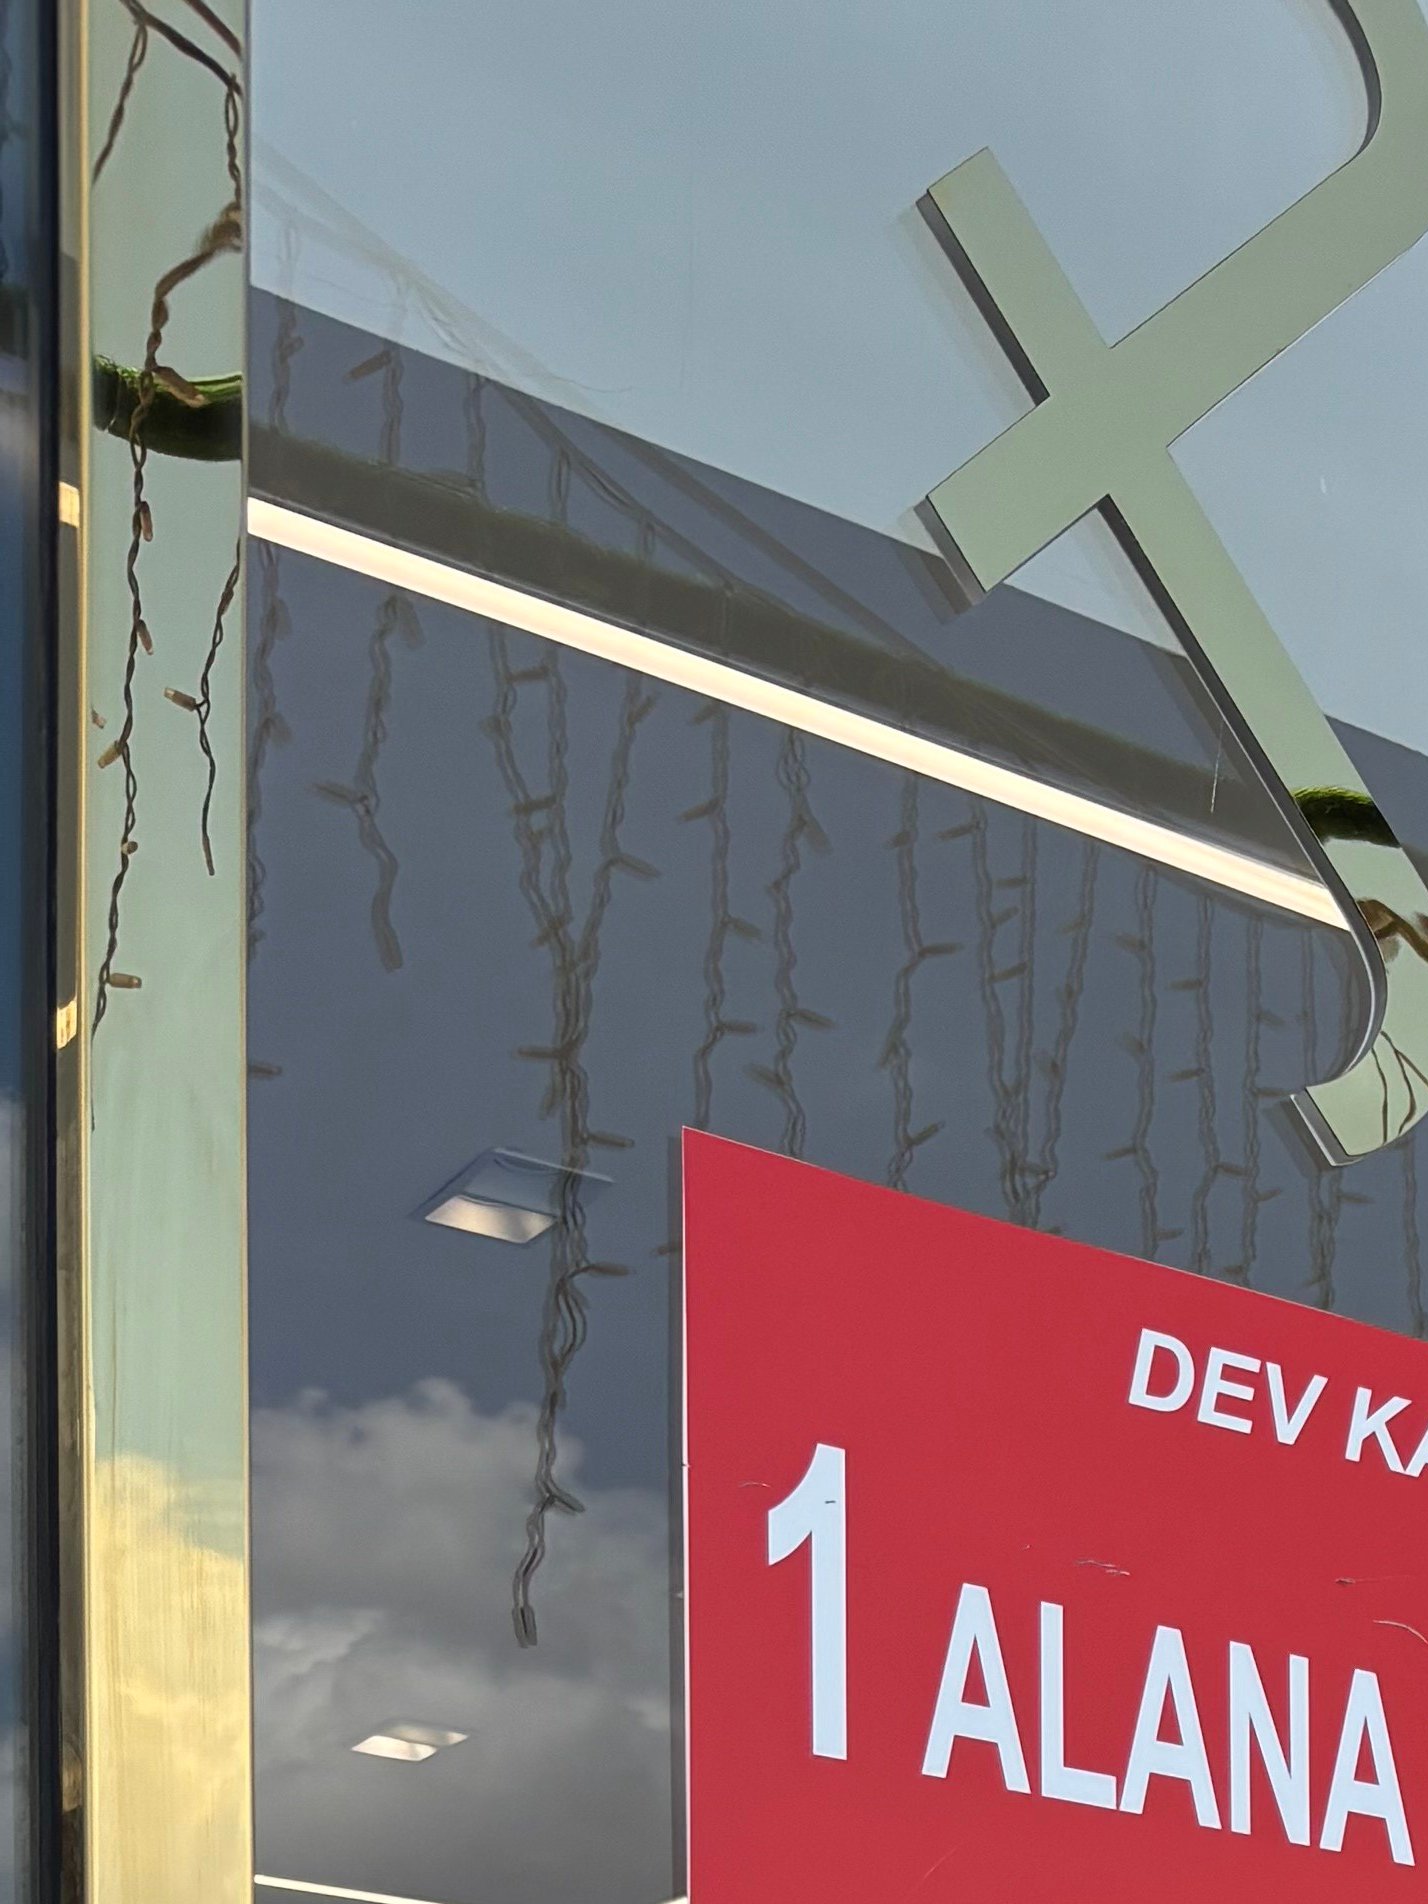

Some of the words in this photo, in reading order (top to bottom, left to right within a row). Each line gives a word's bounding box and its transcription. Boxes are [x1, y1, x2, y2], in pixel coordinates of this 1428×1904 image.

[1128, 1327, 1329, 1447] DEV
[767, 1442, 848, 1761] 1
[921, 1582, 1416, 1868] ALANA
